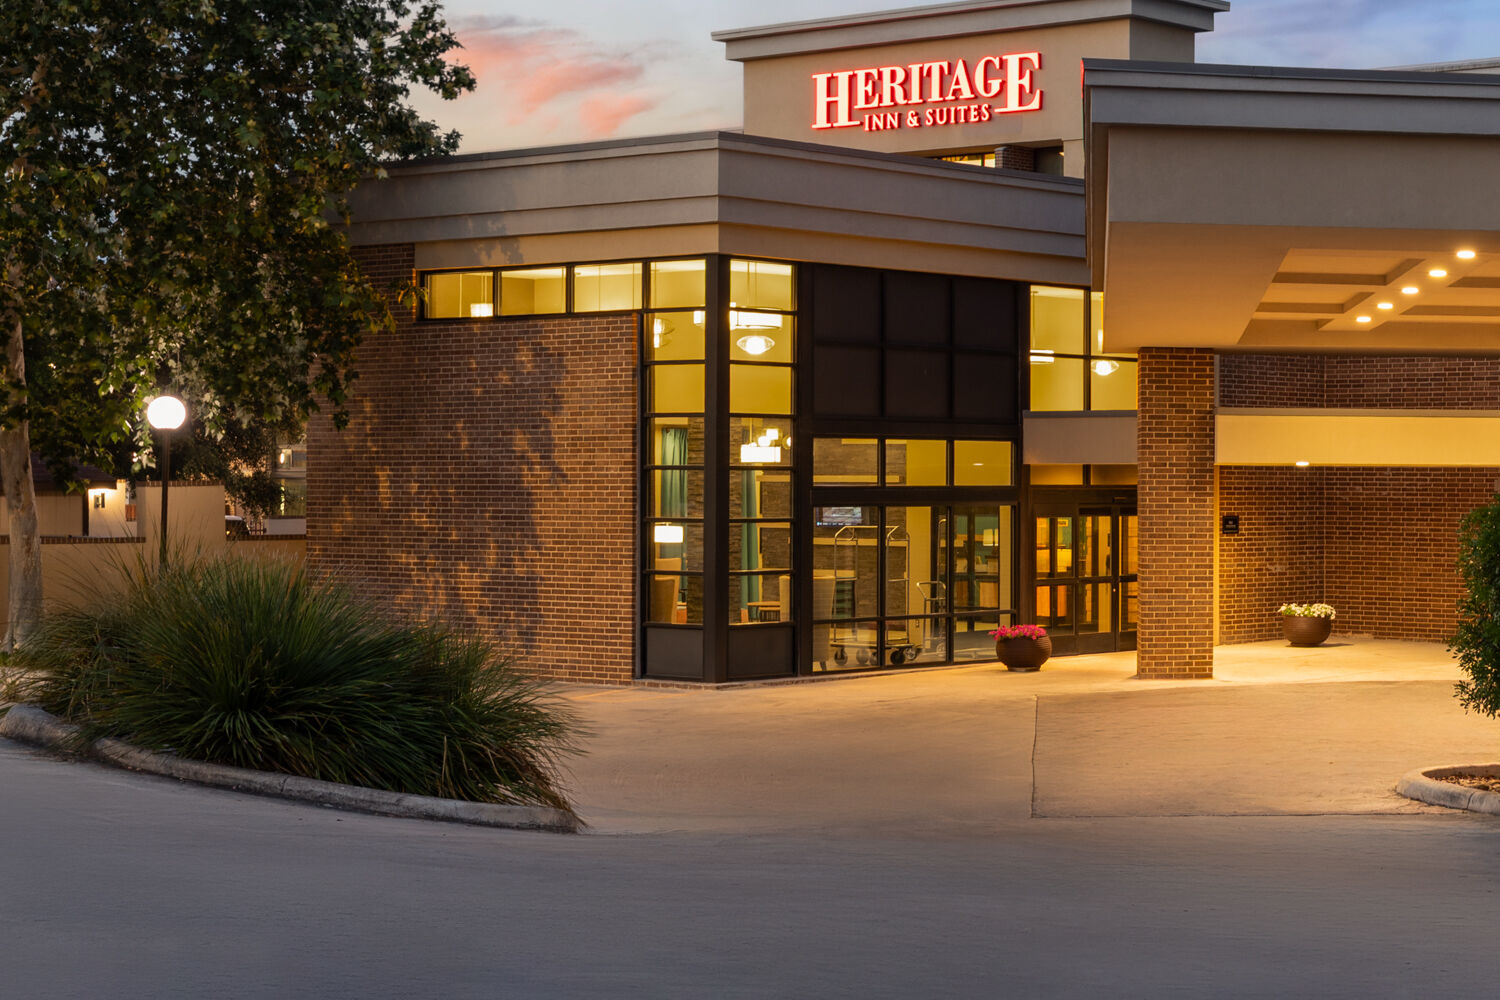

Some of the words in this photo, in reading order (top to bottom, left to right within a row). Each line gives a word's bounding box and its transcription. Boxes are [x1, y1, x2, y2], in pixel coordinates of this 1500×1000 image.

[811, 52, 1042, 129] HERITAGE
[863, 112, 900, 132] INN
[905, 109, 921, 128] &
[924, 103, 991, 127] SUITES
